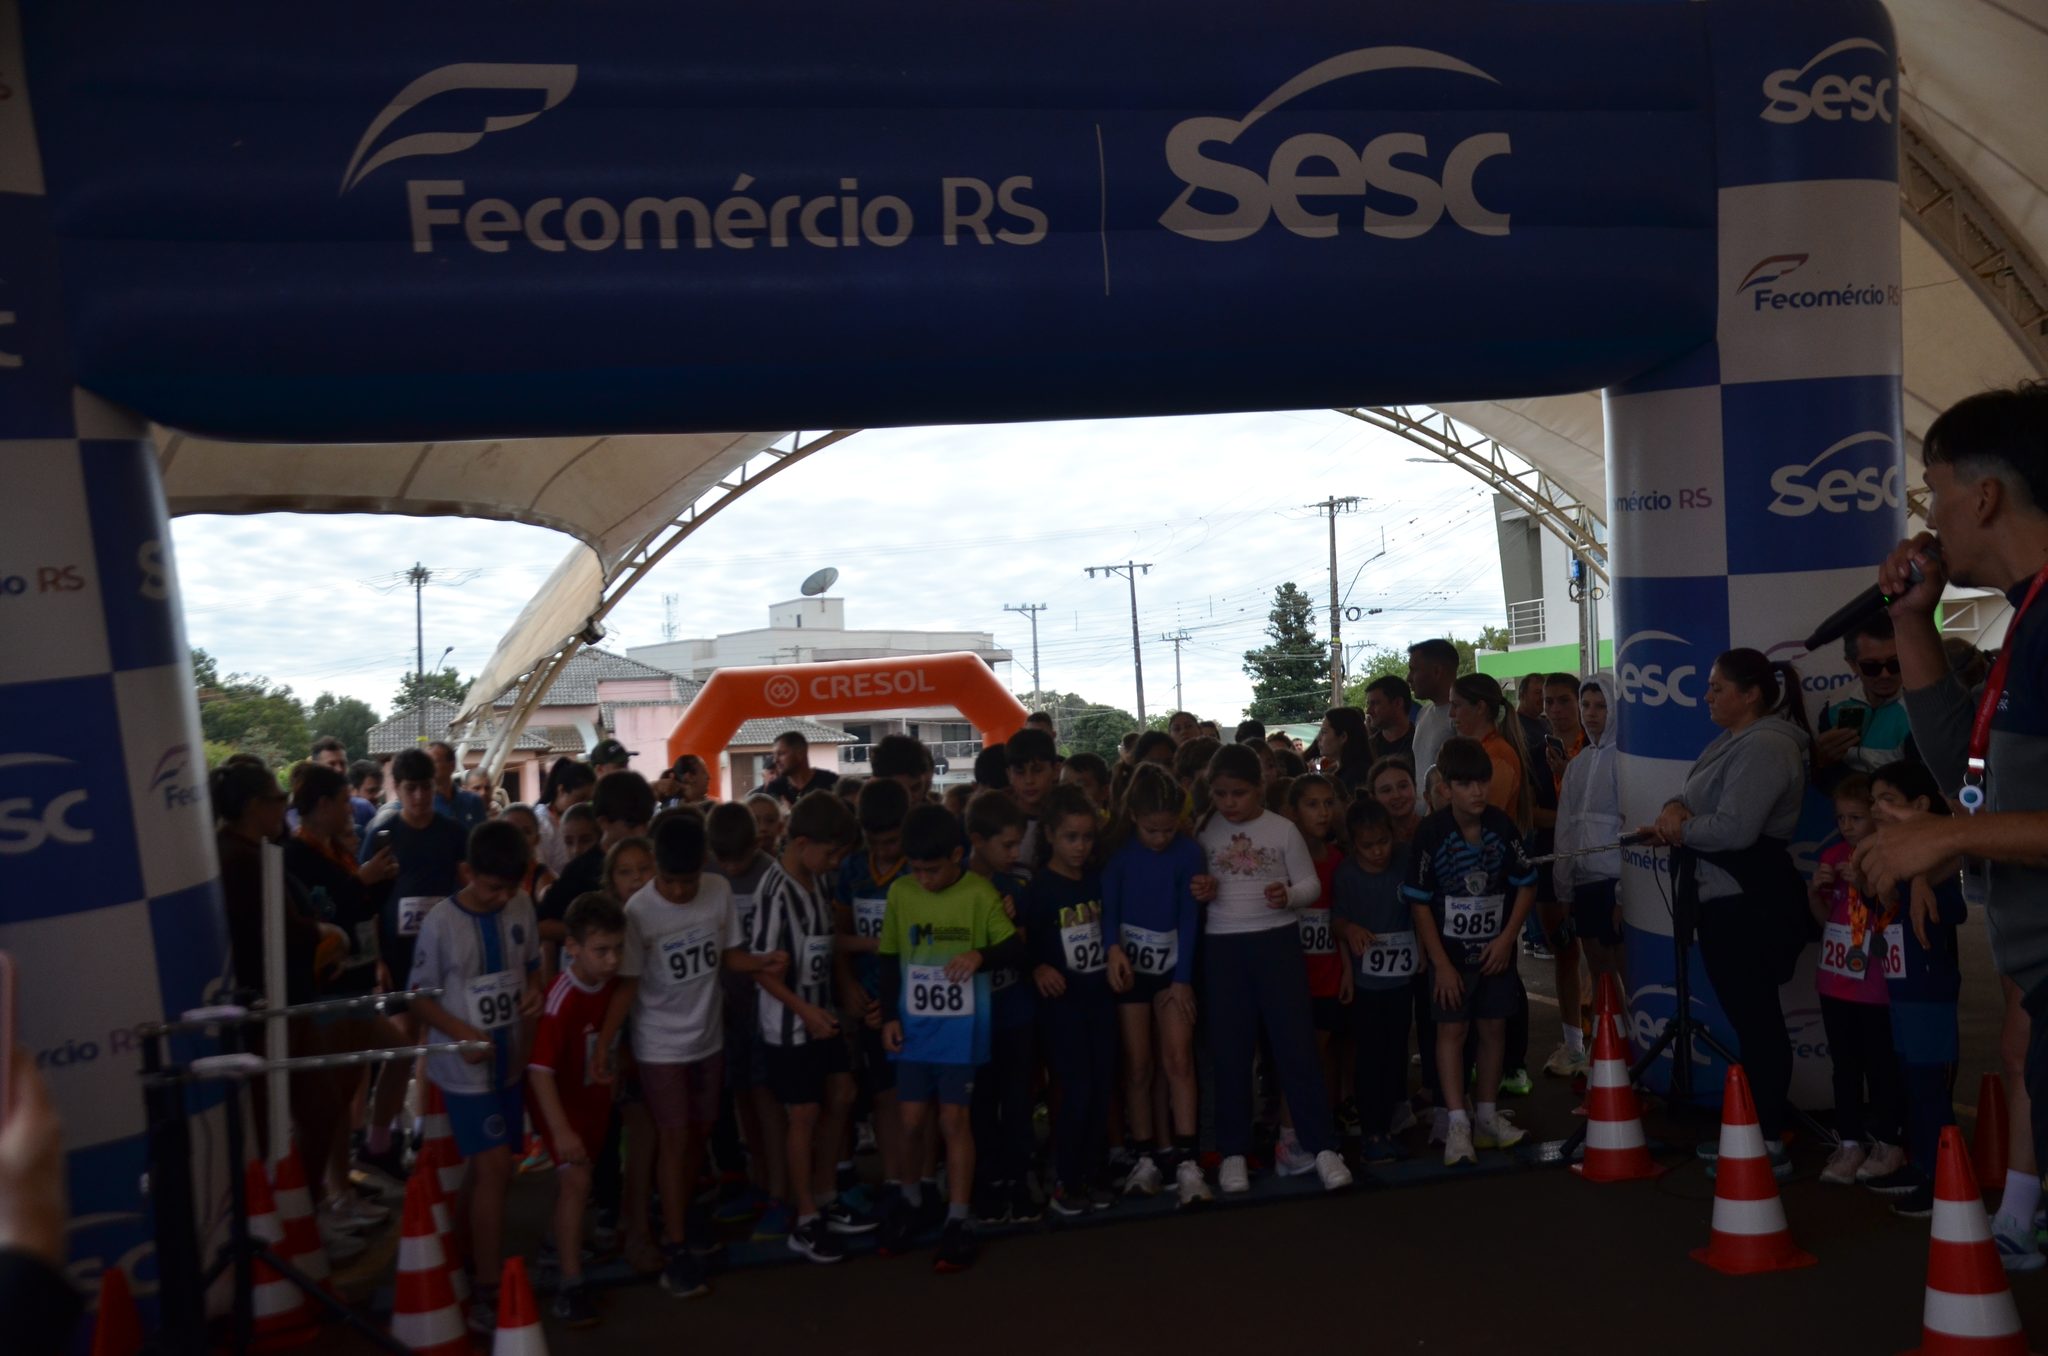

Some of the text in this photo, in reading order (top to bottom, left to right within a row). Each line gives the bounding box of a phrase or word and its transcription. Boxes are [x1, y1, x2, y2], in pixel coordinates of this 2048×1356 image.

[1156, 116, 1512, 243] Sesc
[406, 173, 1050, 253] Fecomércio RS
[1754, 283, 1885, 311] Fecomércio
[1679, 487, 1713, 509] RS
[38, 565, 86, 594] RS
[809, 669, 936, 701] CRESOL
[1453, 910, 1496, 935] 985
[669, 940, 718, 979] 976
[1074, 940, 1104, 971] 92
[1126, 941, 1170, 971] 967
[1370, 947, 1413, 972] 973
[1824, 940, 1846, 969] 28
[478, 988, 522, 1025] 99
[914, 984, 963, 1011] 968
